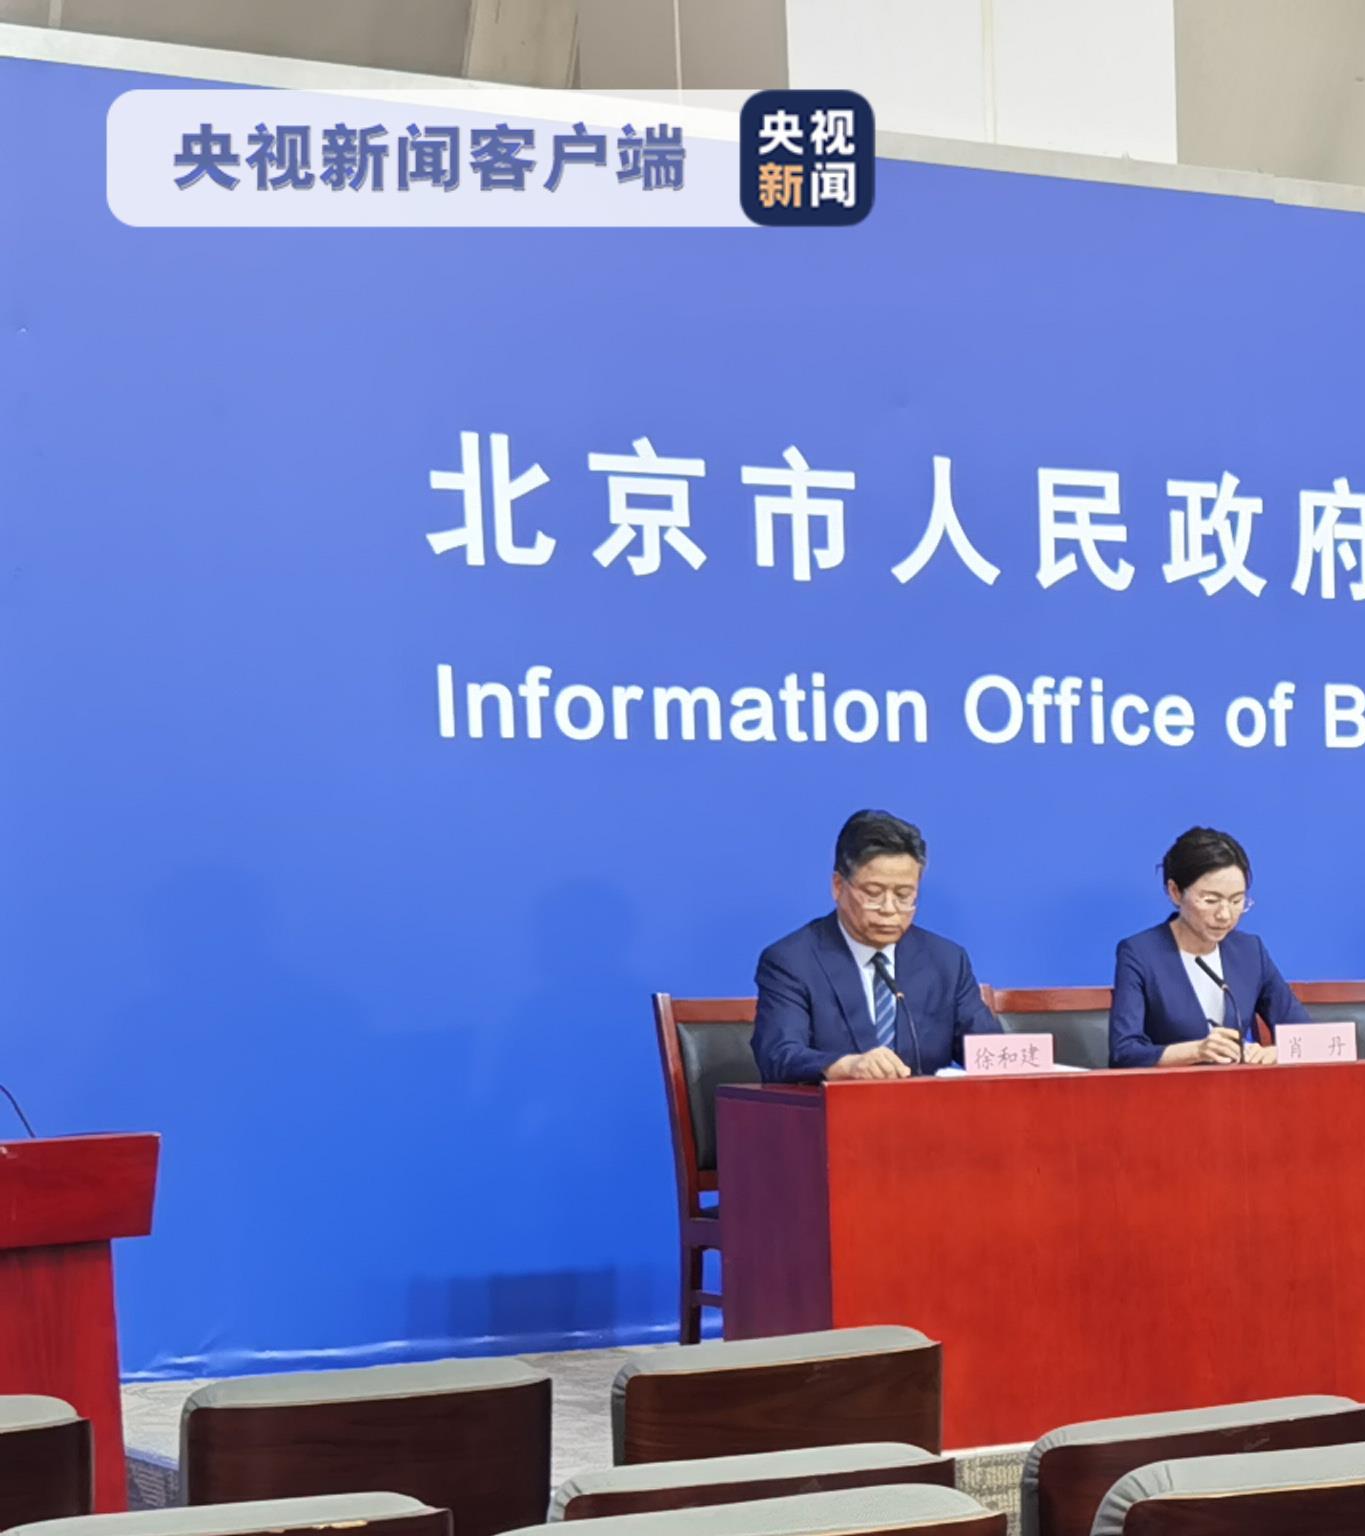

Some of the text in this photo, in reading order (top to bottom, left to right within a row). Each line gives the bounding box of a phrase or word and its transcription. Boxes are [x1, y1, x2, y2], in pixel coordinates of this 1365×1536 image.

[437, 664, 928, 743] Information
[964, 675, 1195, 747] Office
[1226, 681, 1296, 748] of
[974, 1042, 1040, 1070] 徐和建
